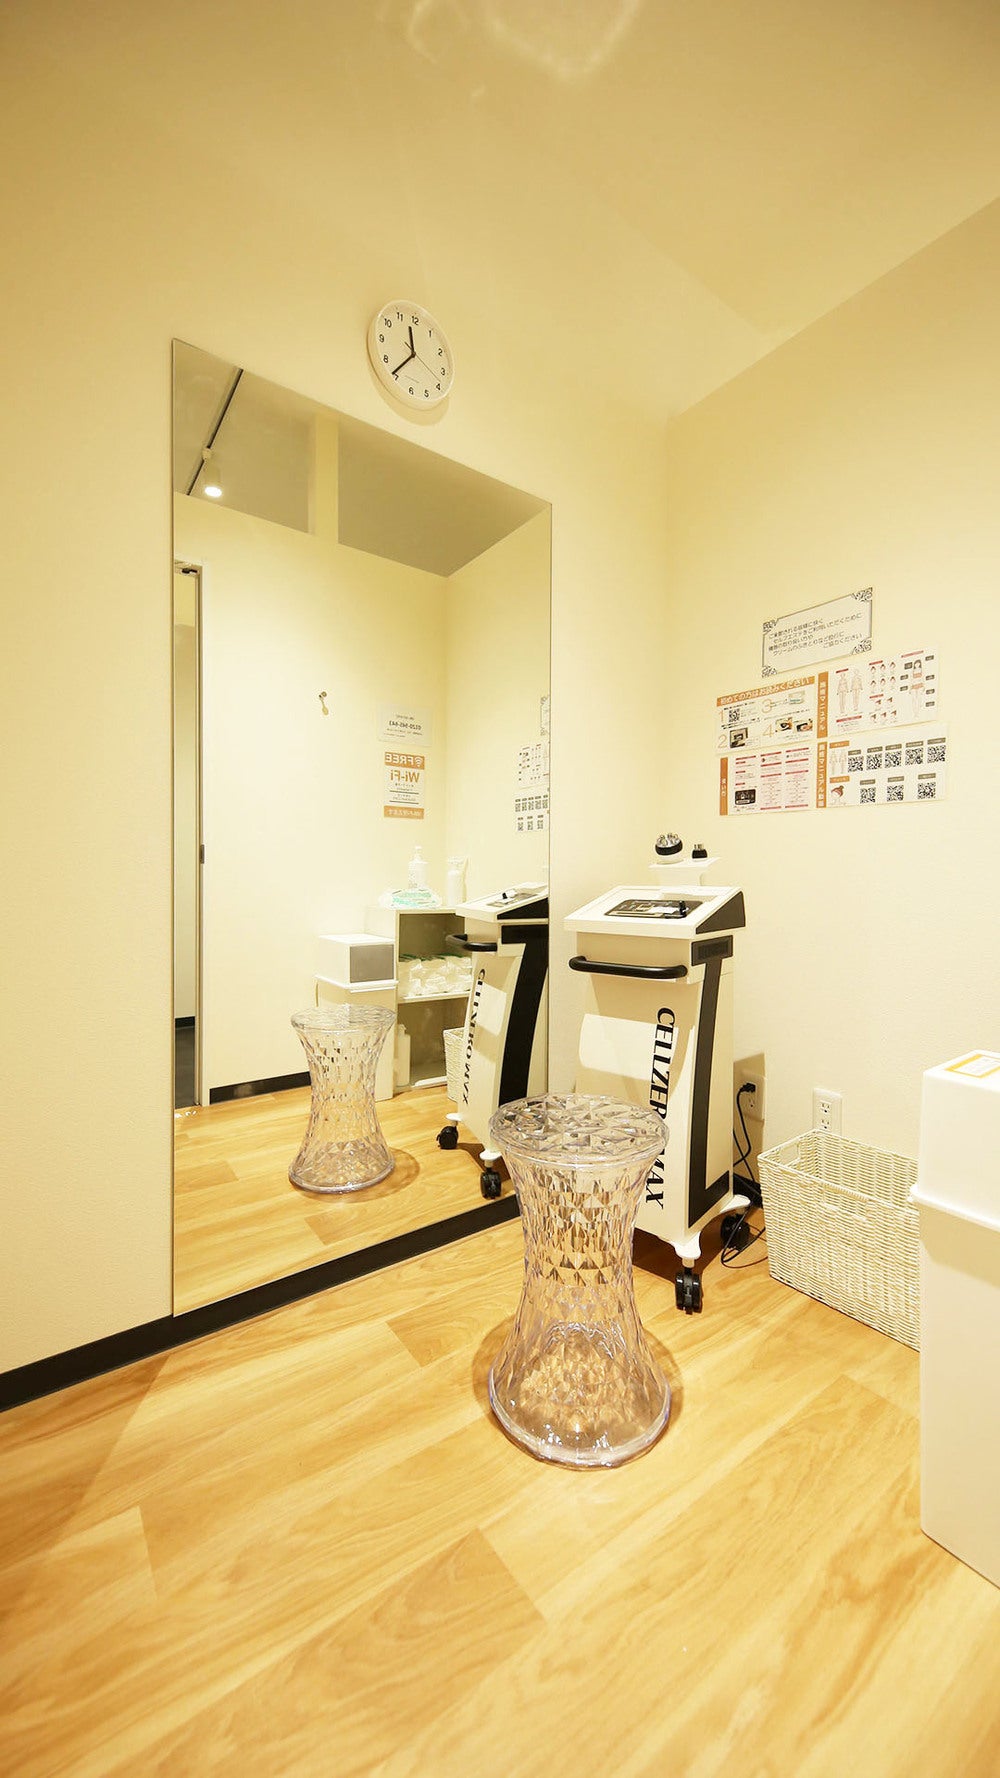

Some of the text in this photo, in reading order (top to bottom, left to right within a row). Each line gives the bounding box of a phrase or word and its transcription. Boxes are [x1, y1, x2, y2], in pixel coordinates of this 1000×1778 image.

[396, 311, 404, 322] 11
[411, 315, 420, 326] 12
[384, 318, 393, 328] 10
[379, 334, 385, 343] 9
[437, 348, 443, 357] 2
[383, 355, 389, 364] 8
[440, 367, 446, 376] 3
[408, 386, 414, 395] 6
[436, 383, 441, 391] 4
[424, 389, 430, 398] 5
[720, 677, 811, 705] 初めての方はお読みください
[761, 698, 772, 714] 3
[718, 709, 724, 722] 1
[762, 724, 774, 738] 4
[717, 734, 727, 749] 2
